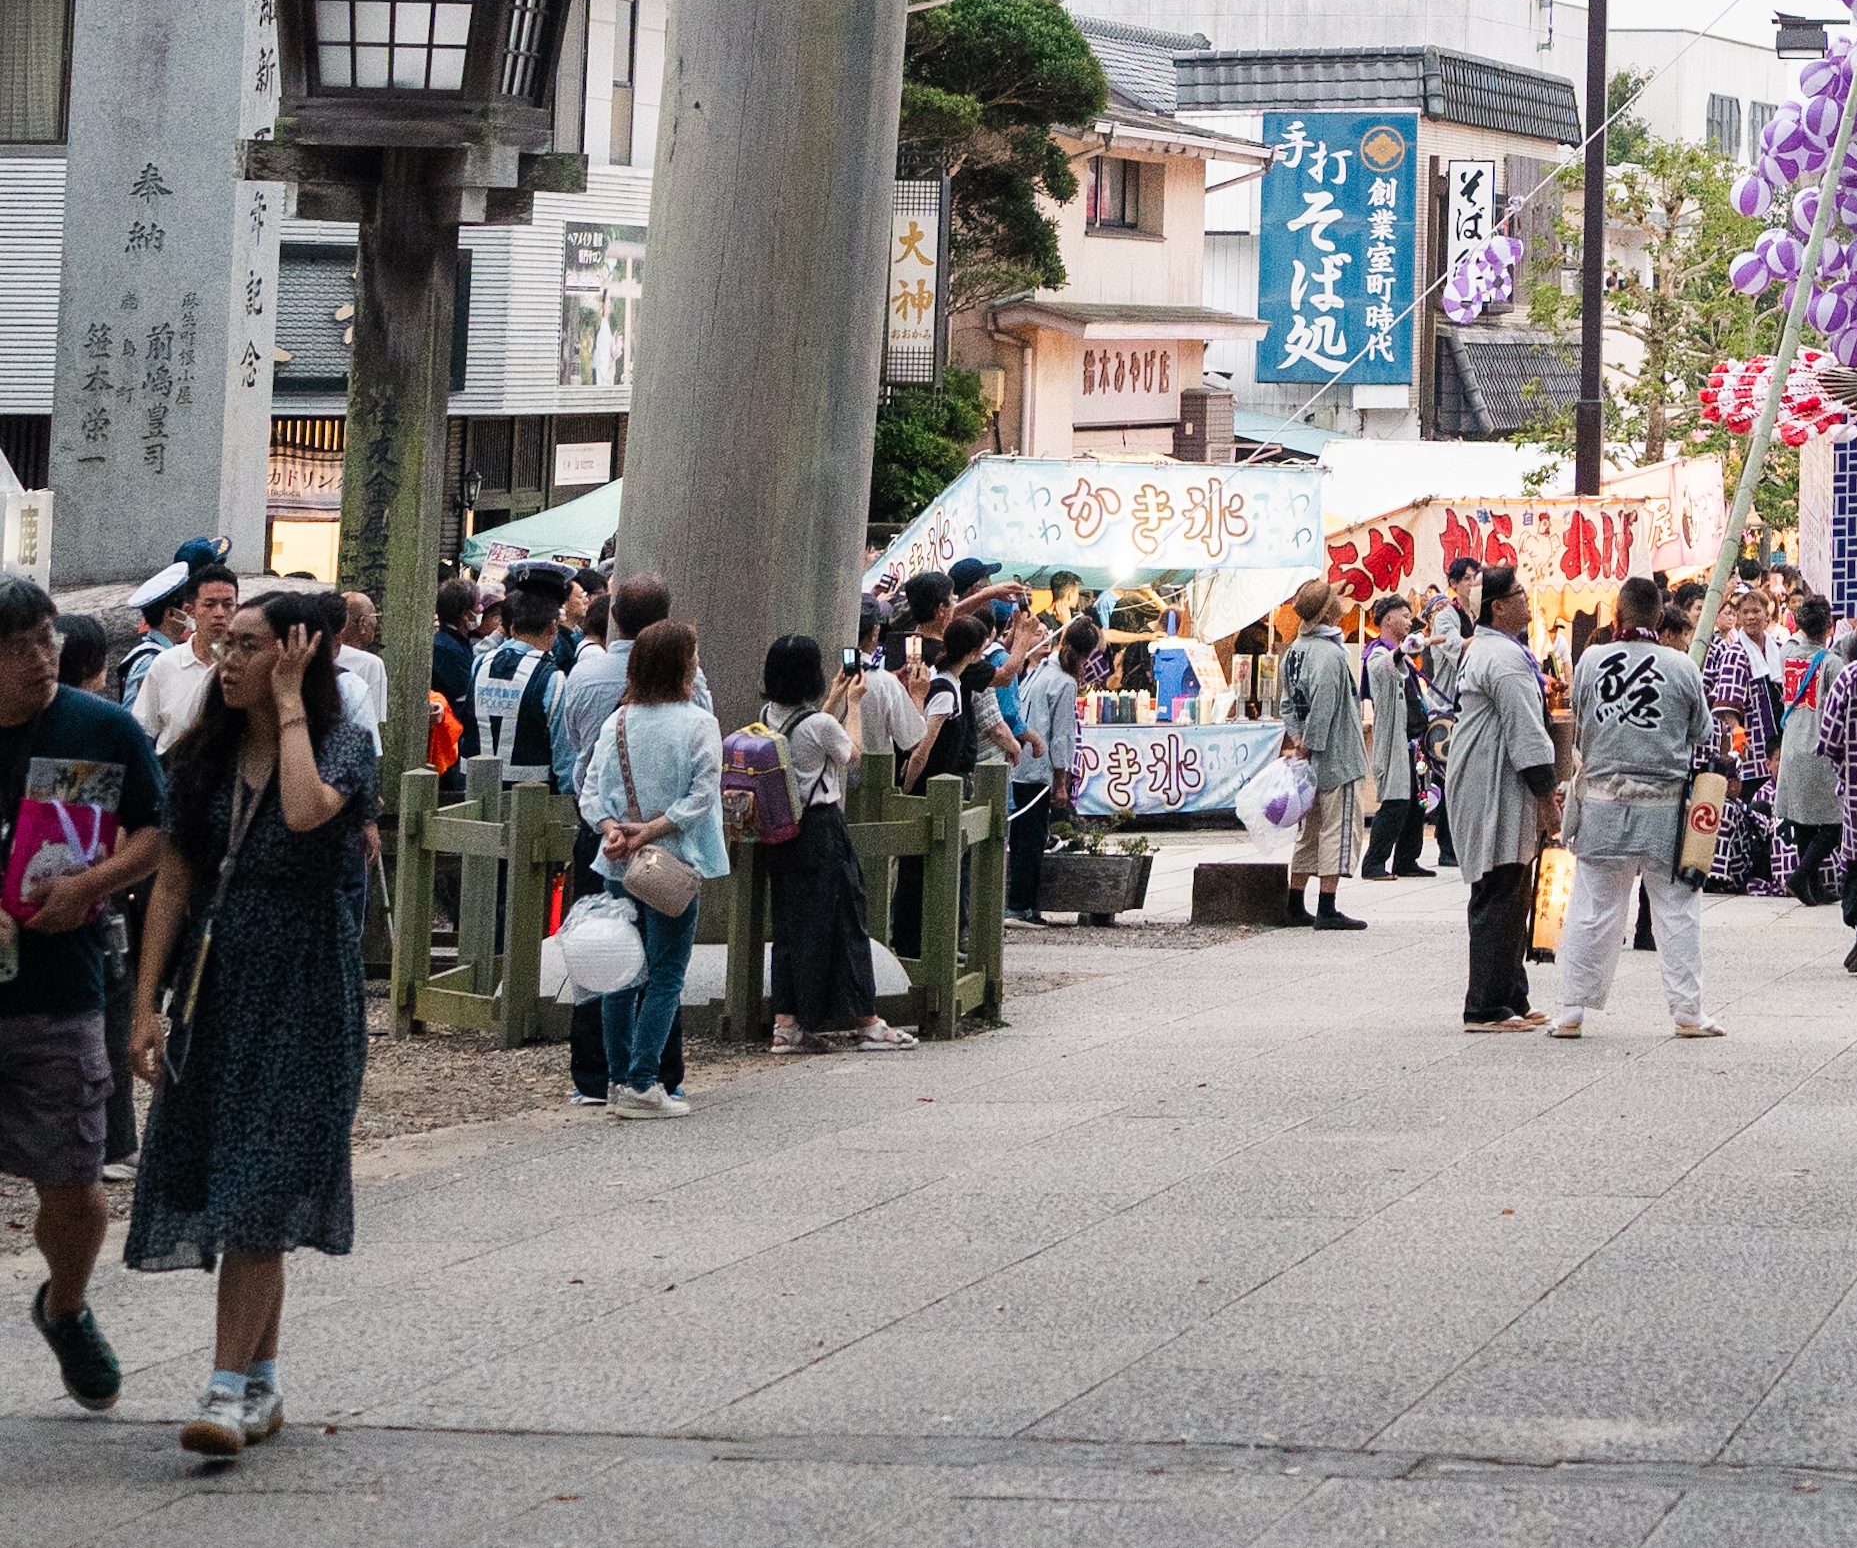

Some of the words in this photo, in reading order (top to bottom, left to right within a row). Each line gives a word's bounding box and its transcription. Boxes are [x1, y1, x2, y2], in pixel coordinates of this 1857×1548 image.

[125, 162, 173, 254] 奉納
[891, 221, 934, 325] 大神
[1366, 177, 1398, 363] 創業室町時代
[1083, 349, 1171, 396] 鈴木みやげ店
[1061, 477, 1249, 557] かき氷
